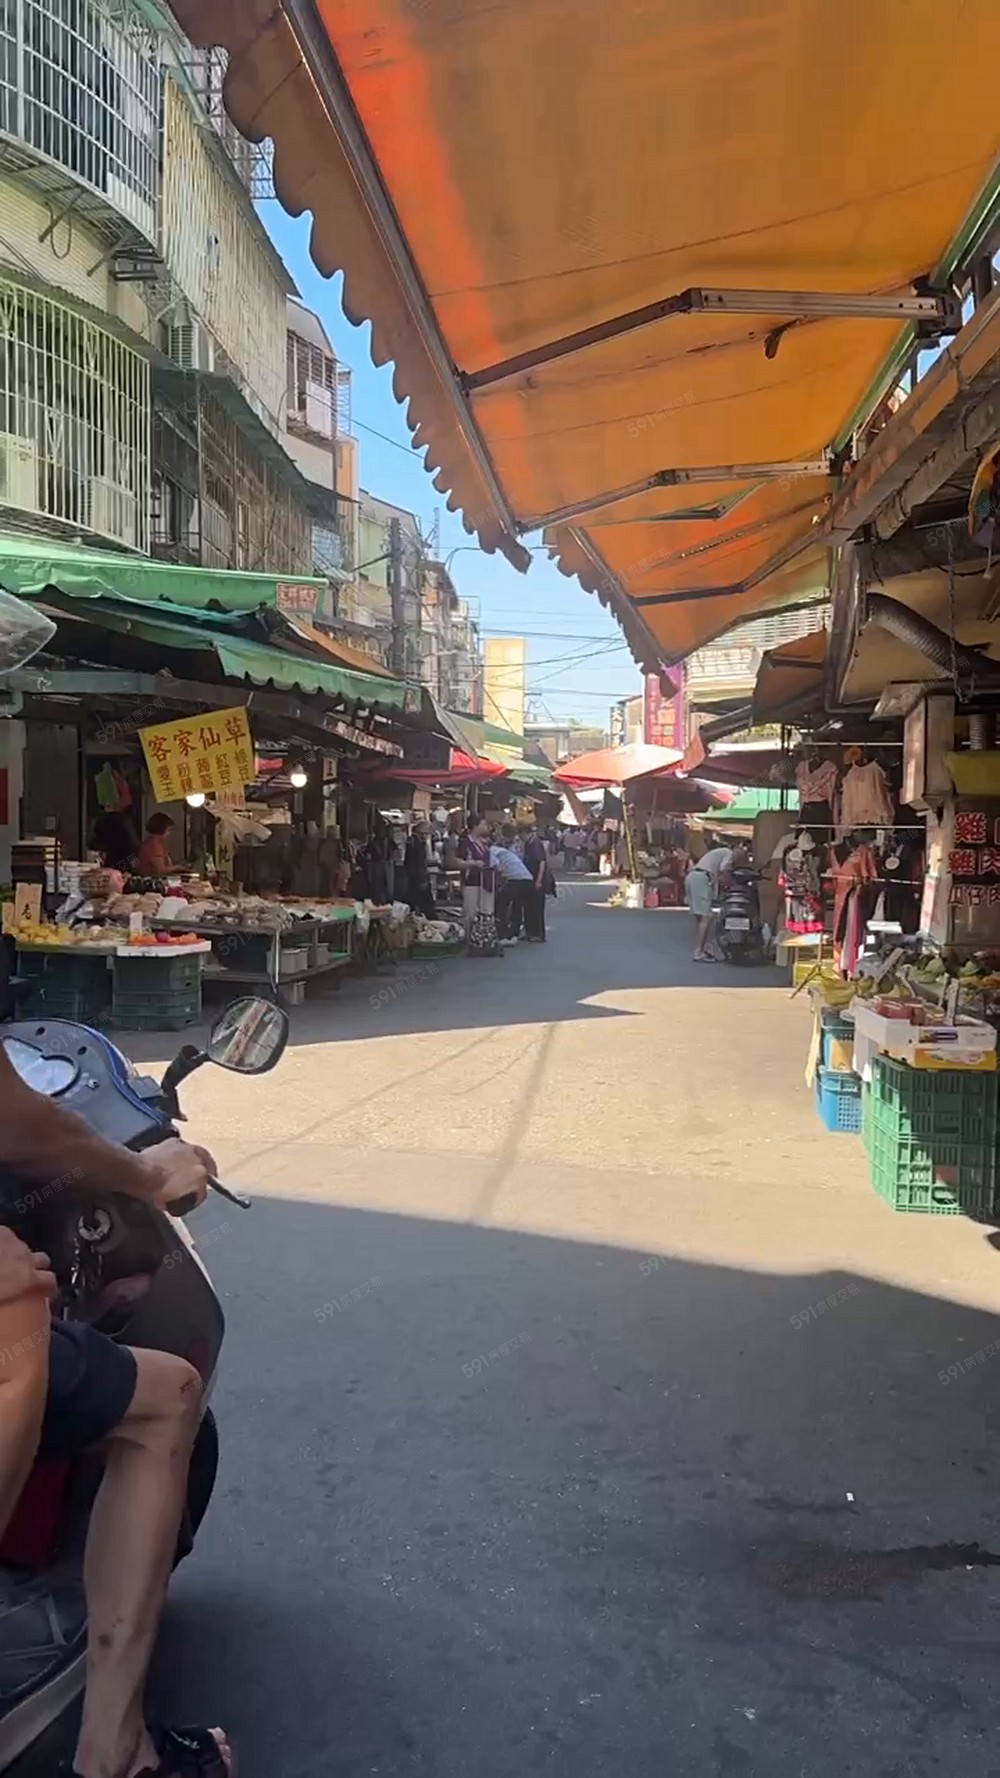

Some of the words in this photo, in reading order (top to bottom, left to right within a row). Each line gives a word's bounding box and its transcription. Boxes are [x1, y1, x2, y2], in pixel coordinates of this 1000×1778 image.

[147, 716, 247, 763] 客家仙草
[215, 753, 233, 786] 紅豆
